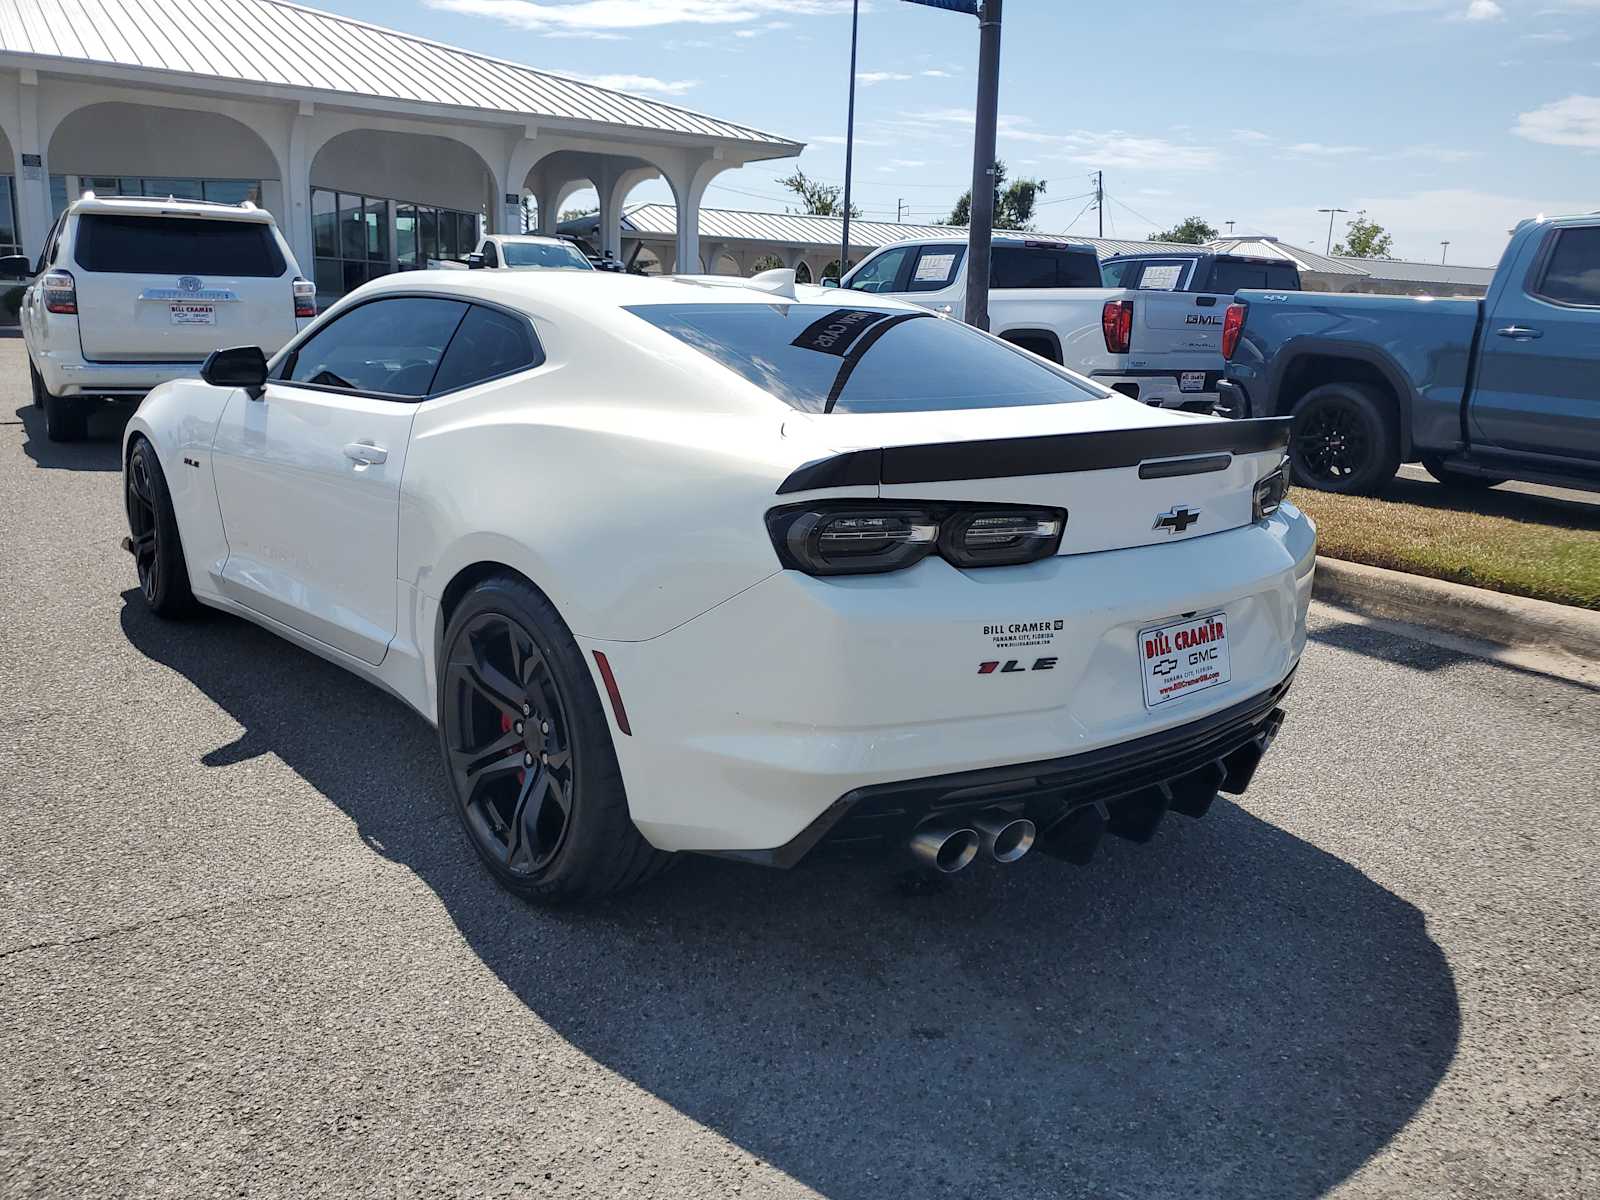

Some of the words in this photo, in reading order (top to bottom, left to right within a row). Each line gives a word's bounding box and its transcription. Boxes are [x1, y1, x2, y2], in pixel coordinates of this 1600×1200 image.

[1185, 314, 1223, 325] GMC
[983, 625, 1005, 635] BILL
[1008, 621, 1051, 634] CRAMER
[1145, 635, 1172, 659] BILL
[1174, 622, 1225, 651] CRAMER
[1188, 647, 1218, 666] GMC
[977, 657, 1059, 674] 1LE
